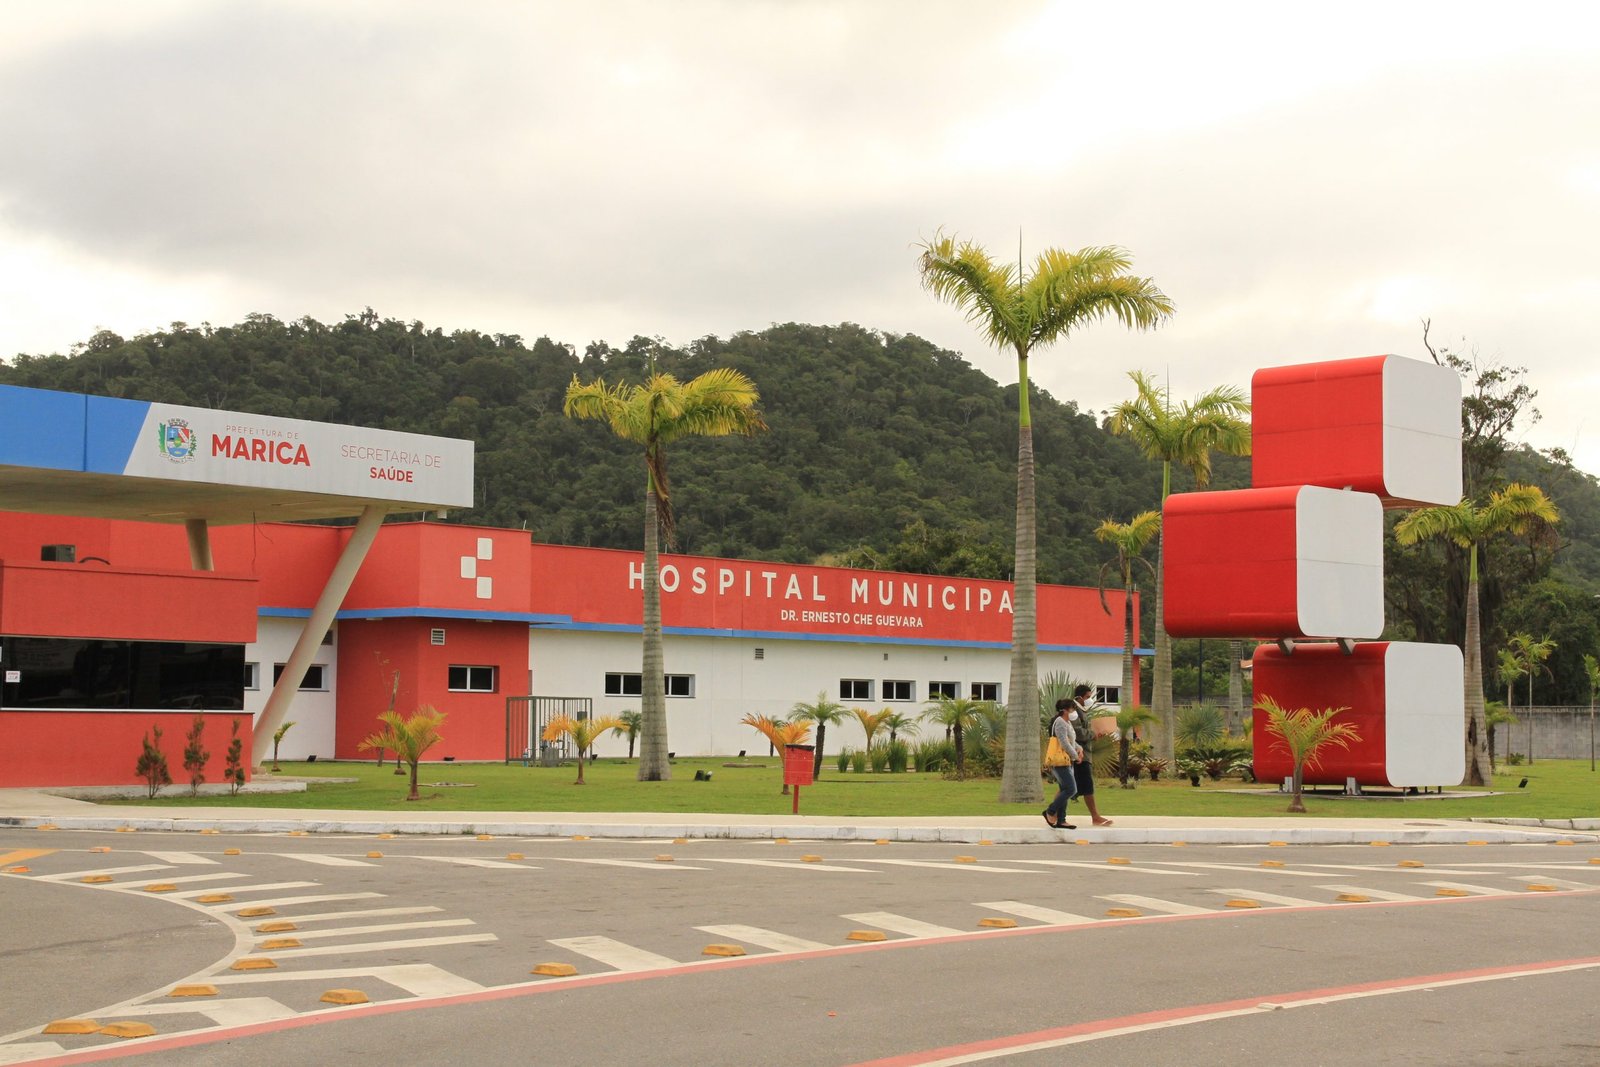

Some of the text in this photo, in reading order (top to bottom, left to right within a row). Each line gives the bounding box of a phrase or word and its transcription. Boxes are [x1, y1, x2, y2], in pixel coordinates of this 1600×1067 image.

[226, 425, 299, 440] PREFEITURA DE
[211, 433, 311, 467] MARICA
[341, 444, 441, 468] SECRETARIA DE
[370, 466, 413, 483] SAÚDE
[629, 561, 1014, 614] HOSPITAL MUNICIPA
[781, 609, 924, 628] DR. ERNESTO CHE GUEVARA
